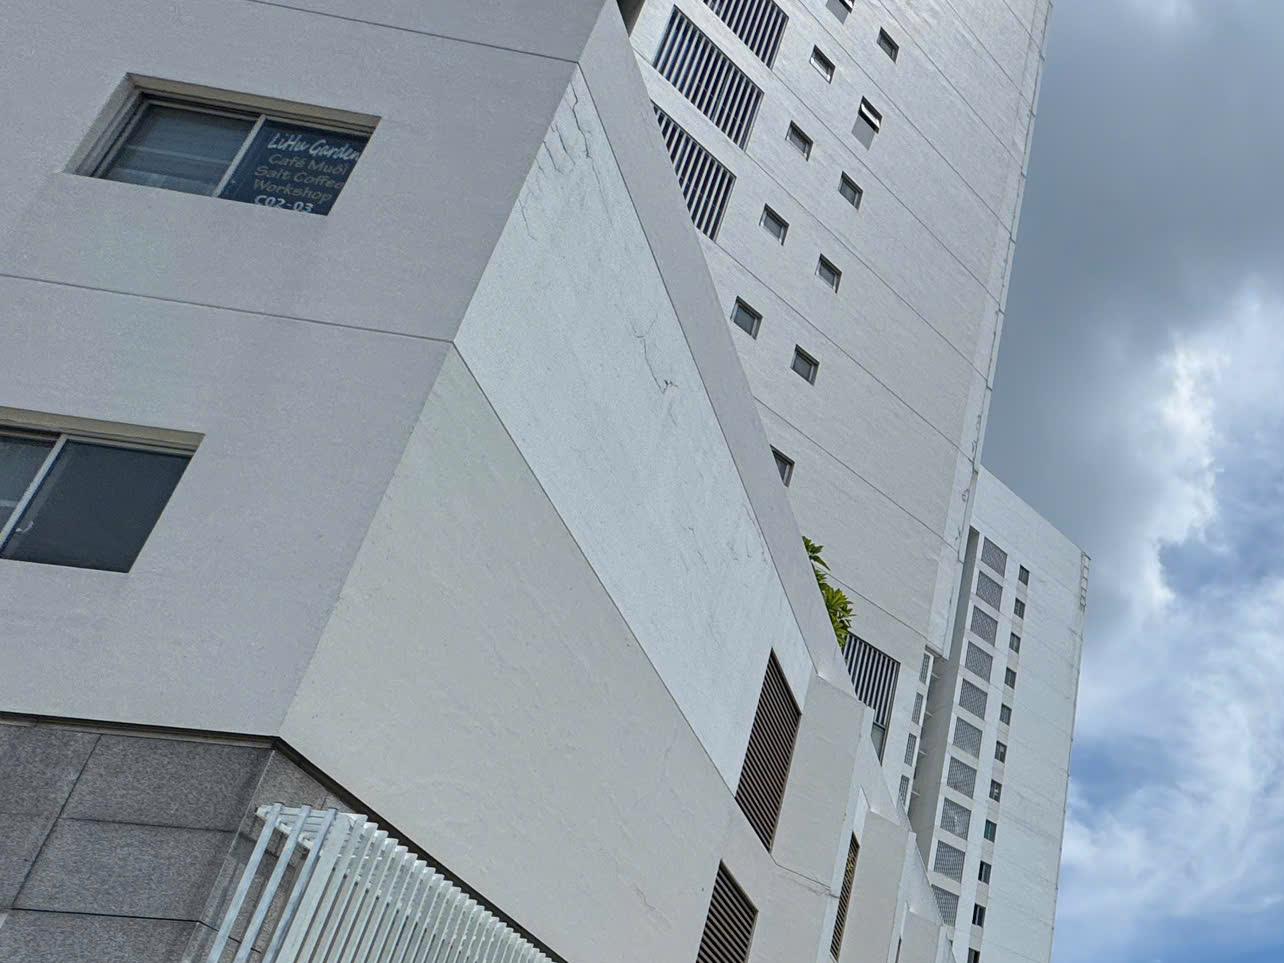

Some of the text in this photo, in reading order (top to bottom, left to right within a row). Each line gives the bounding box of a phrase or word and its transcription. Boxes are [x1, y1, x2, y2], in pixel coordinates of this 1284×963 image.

[309, 139, 360, 160] Garden
[267, 153, 306, 168] Café
[254, 165, 291, 180] Salt
[254, 178, 332, 204] Workshop
